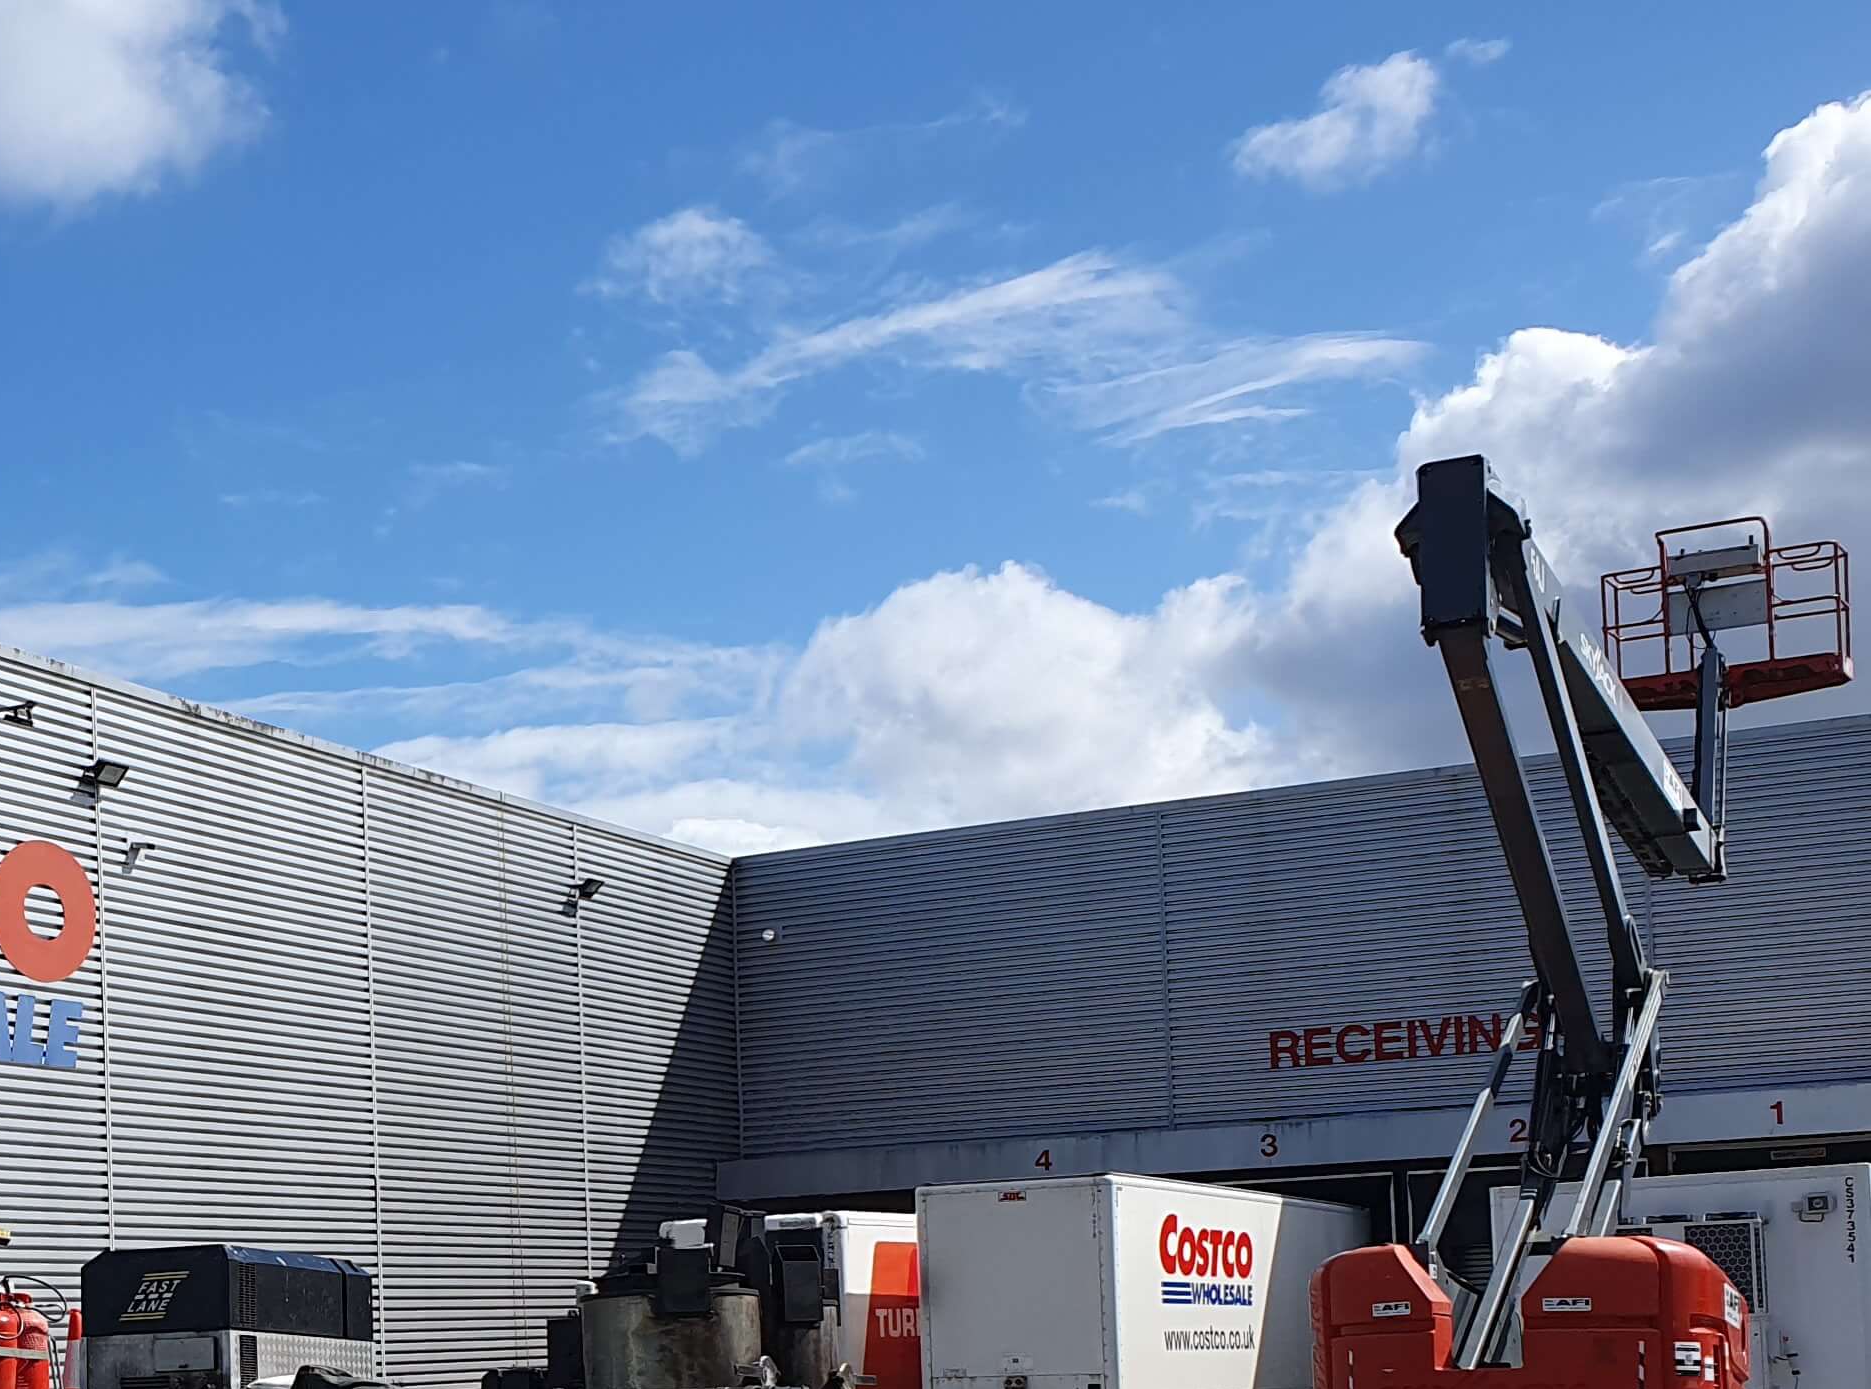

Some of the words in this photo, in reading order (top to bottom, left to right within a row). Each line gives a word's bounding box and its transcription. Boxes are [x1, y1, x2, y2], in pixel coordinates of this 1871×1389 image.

[1769, 1100, 1784, 1125] 1
[1509, 1118, 1529, 1143] 2
[1260, 1133, 1278, 1158] 3
[1034, 1149, 1053, 1171] 4
[1844, 1176, 1856, 1264] CS373541
[1159, 1213, 1253, 1279] COSTCO
[137, 1279, 181, 1294] FAST
[1191, 1282, 1253, 1306] WHOLESALE
[126, 1298, 170, 1313] LANE
[875, 1308, 921, 1338] TUR
[1164, 1324, 1255, 1351] www.costco.co.uk
